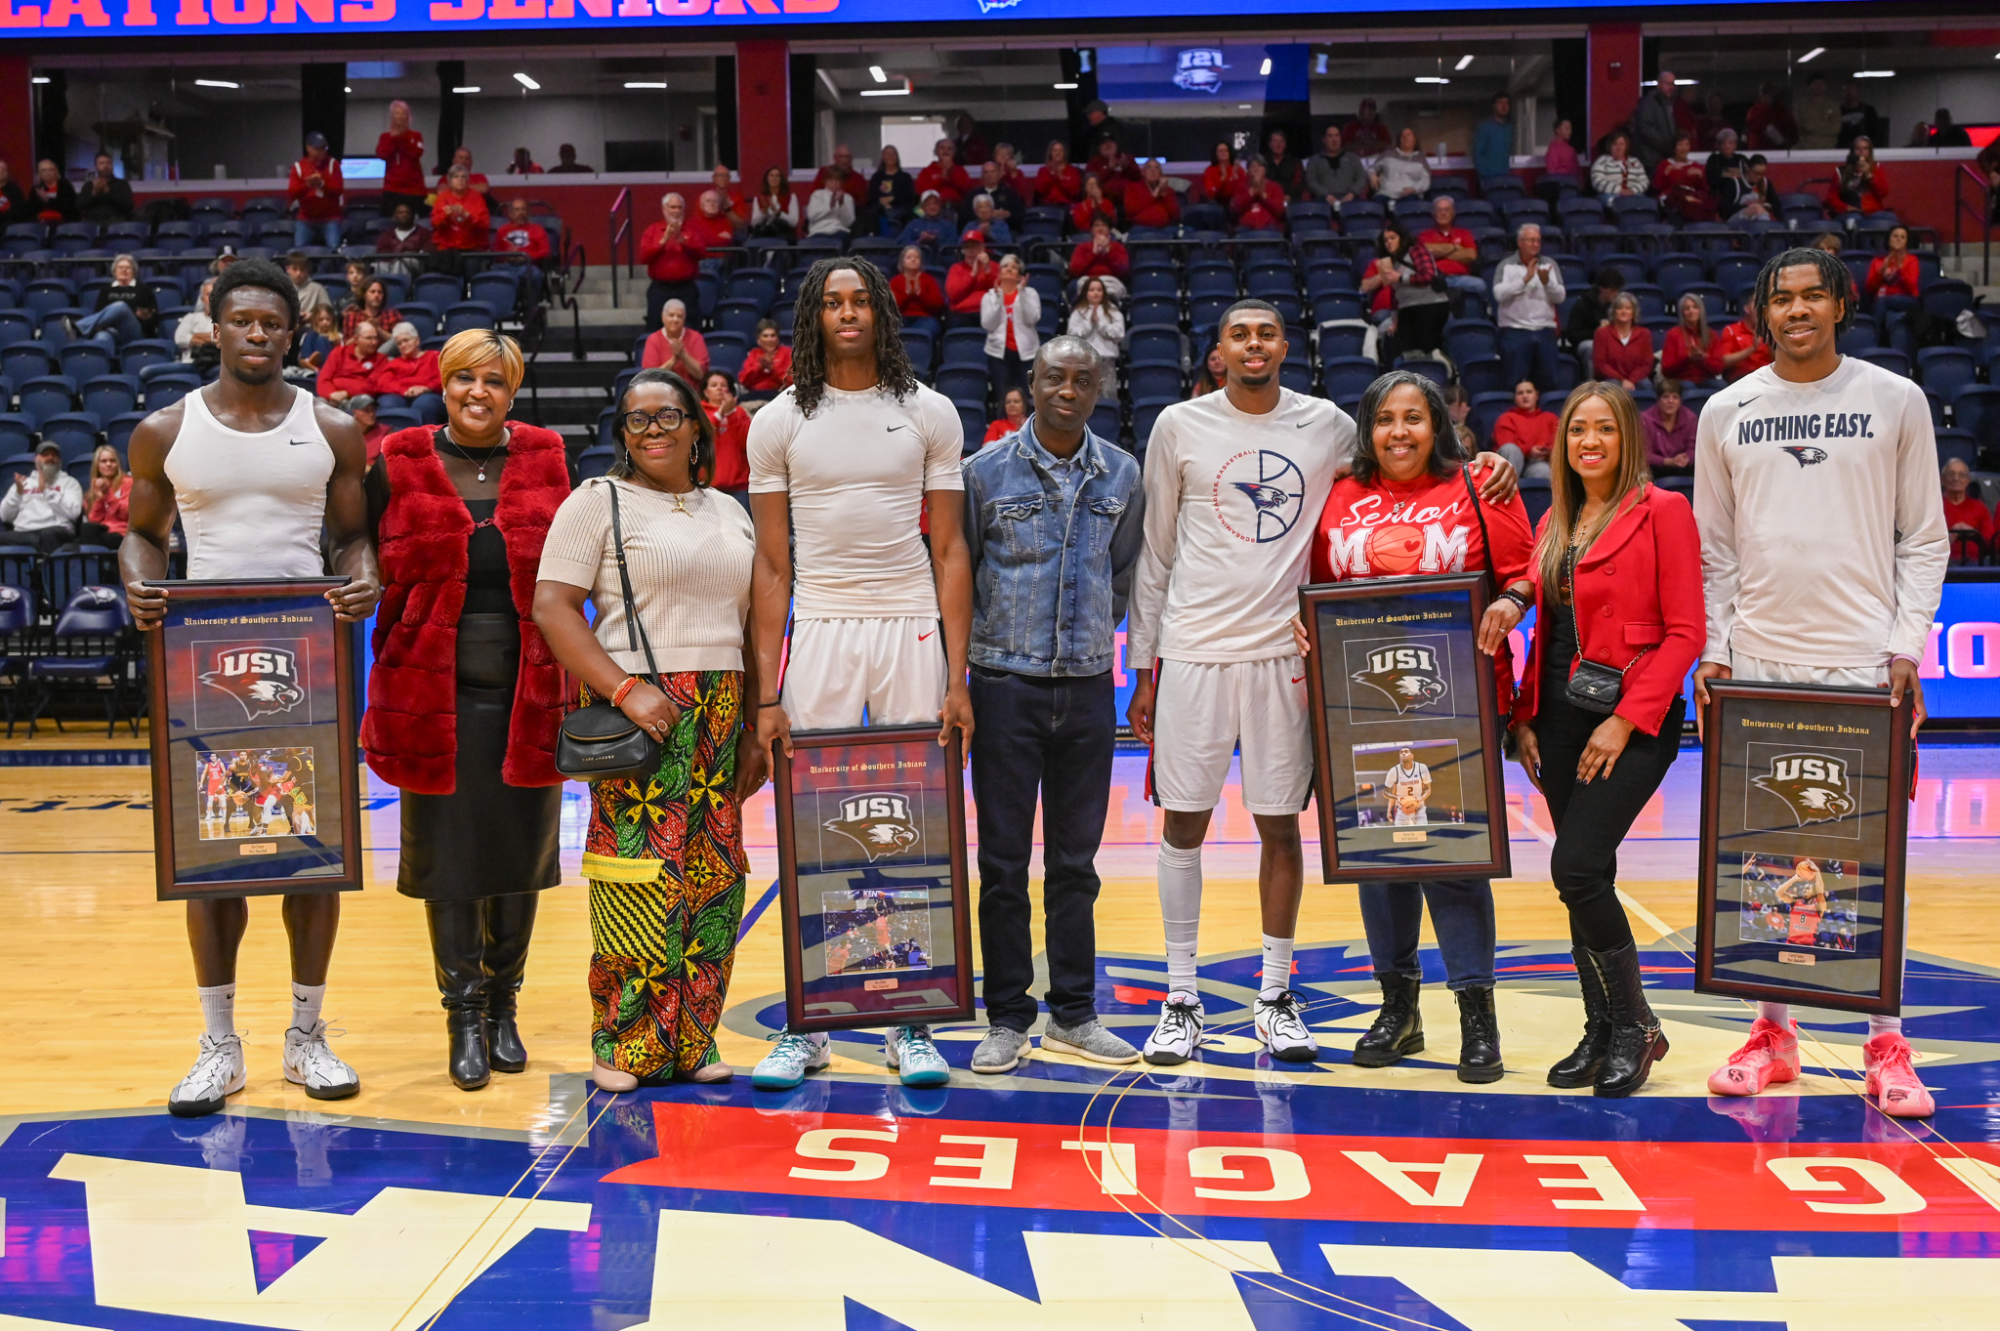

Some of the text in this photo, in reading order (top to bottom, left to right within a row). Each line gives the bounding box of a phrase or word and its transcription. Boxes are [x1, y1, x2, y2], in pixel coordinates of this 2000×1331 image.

[1738, 413, 1874, 445] NOTHING EASY.
[1216, 449, 1257, 479] BASKETBALL
[1340, 495, 1463, 527] Senior
[1218, 514, 1256, 543] SCREAMING
[183, 614, 313, 626] University of Southern Indiana
[1335, 612, 1452, 627] University of Southern Indiana
[223, 652, 290, 677] USI
[1372, 649, 1432, 674] USI
[1742, 718, 1870, 735] University of Southern Indiana
[810, 760, 927, 774] University of Southern Indiana
[1776, 758, 1842, 786] USI
[1407, 786, 1413, 796] 2
[845, 797, 906, 822] USI
[1801, 913, 1806, 924] 8
[787, 1128, 1647, 1212] EAGLES
